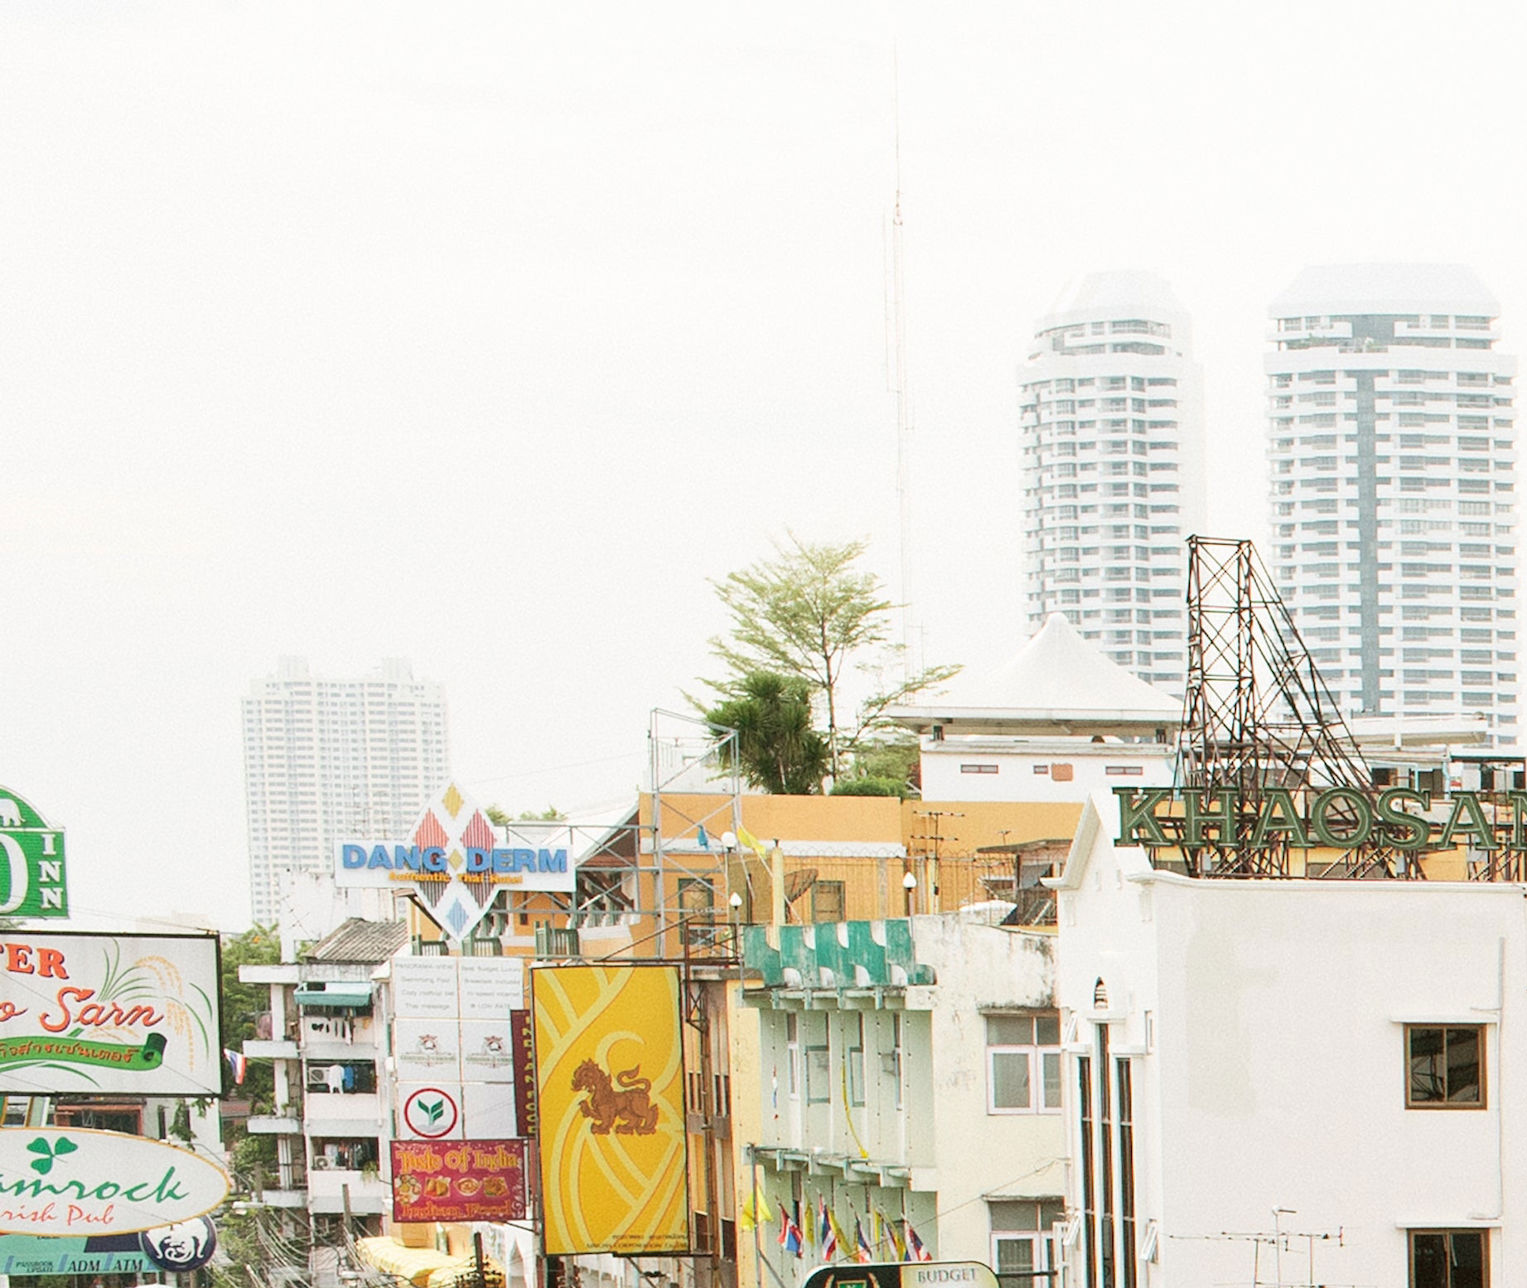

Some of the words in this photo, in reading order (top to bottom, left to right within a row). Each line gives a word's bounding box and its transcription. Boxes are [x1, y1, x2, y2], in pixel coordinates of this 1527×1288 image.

[343, 845, 447, 872] DANG
[467, 848, 567, 873] DERM
[39, 987, 164, 1032] Sarn
[67, 1204, 114, 1226] Pub
[68, 1259, 101, 1272] ADM
[115, 1258, 143, 1271] ATM
[918, 1267, 979, 1283] BUDGET
